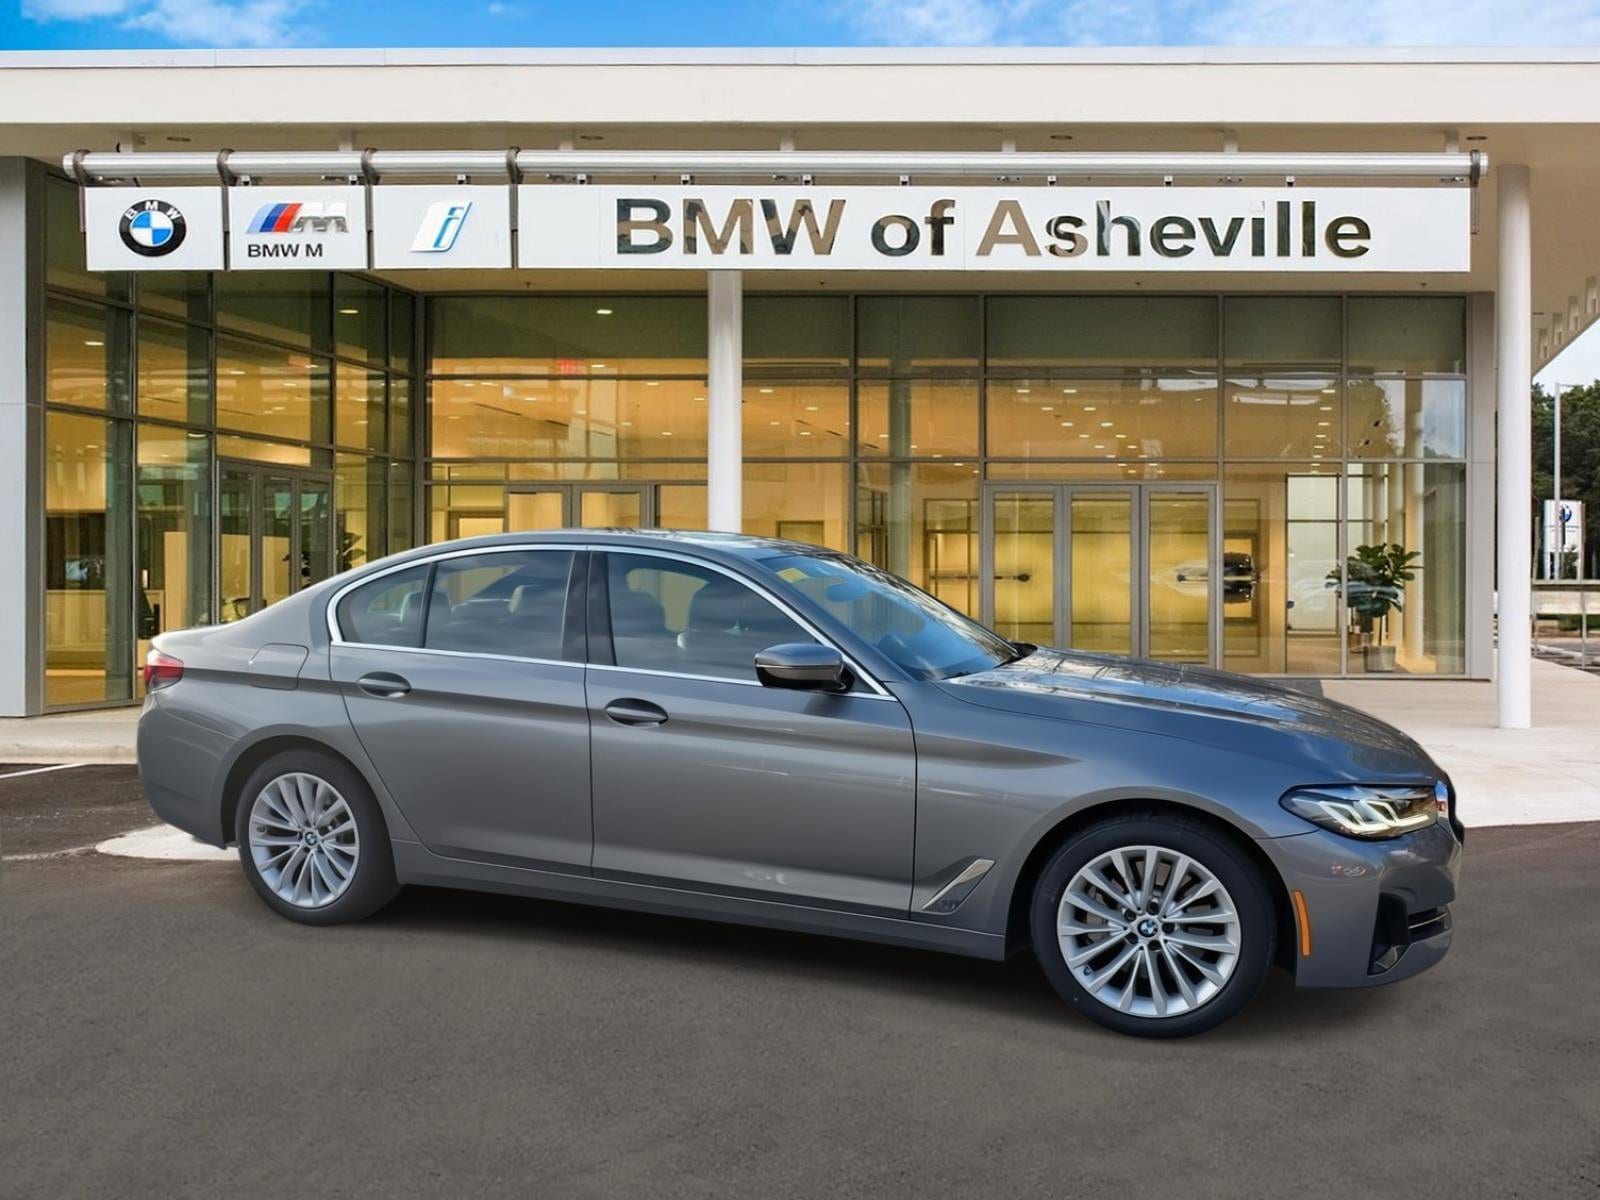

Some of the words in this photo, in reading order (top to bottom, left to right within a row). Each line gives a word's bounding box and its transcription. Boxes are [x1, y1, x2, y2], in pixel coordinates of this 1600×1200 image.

[124, 201, 181, 220] BMW
[616, 199, 846, 255] BMW
[870, 199, 956, 257] of
[975, 199, 1372, 258] Asheville
[248, 243, 299, 258] BMW
[305, 243, 324, 258] M
